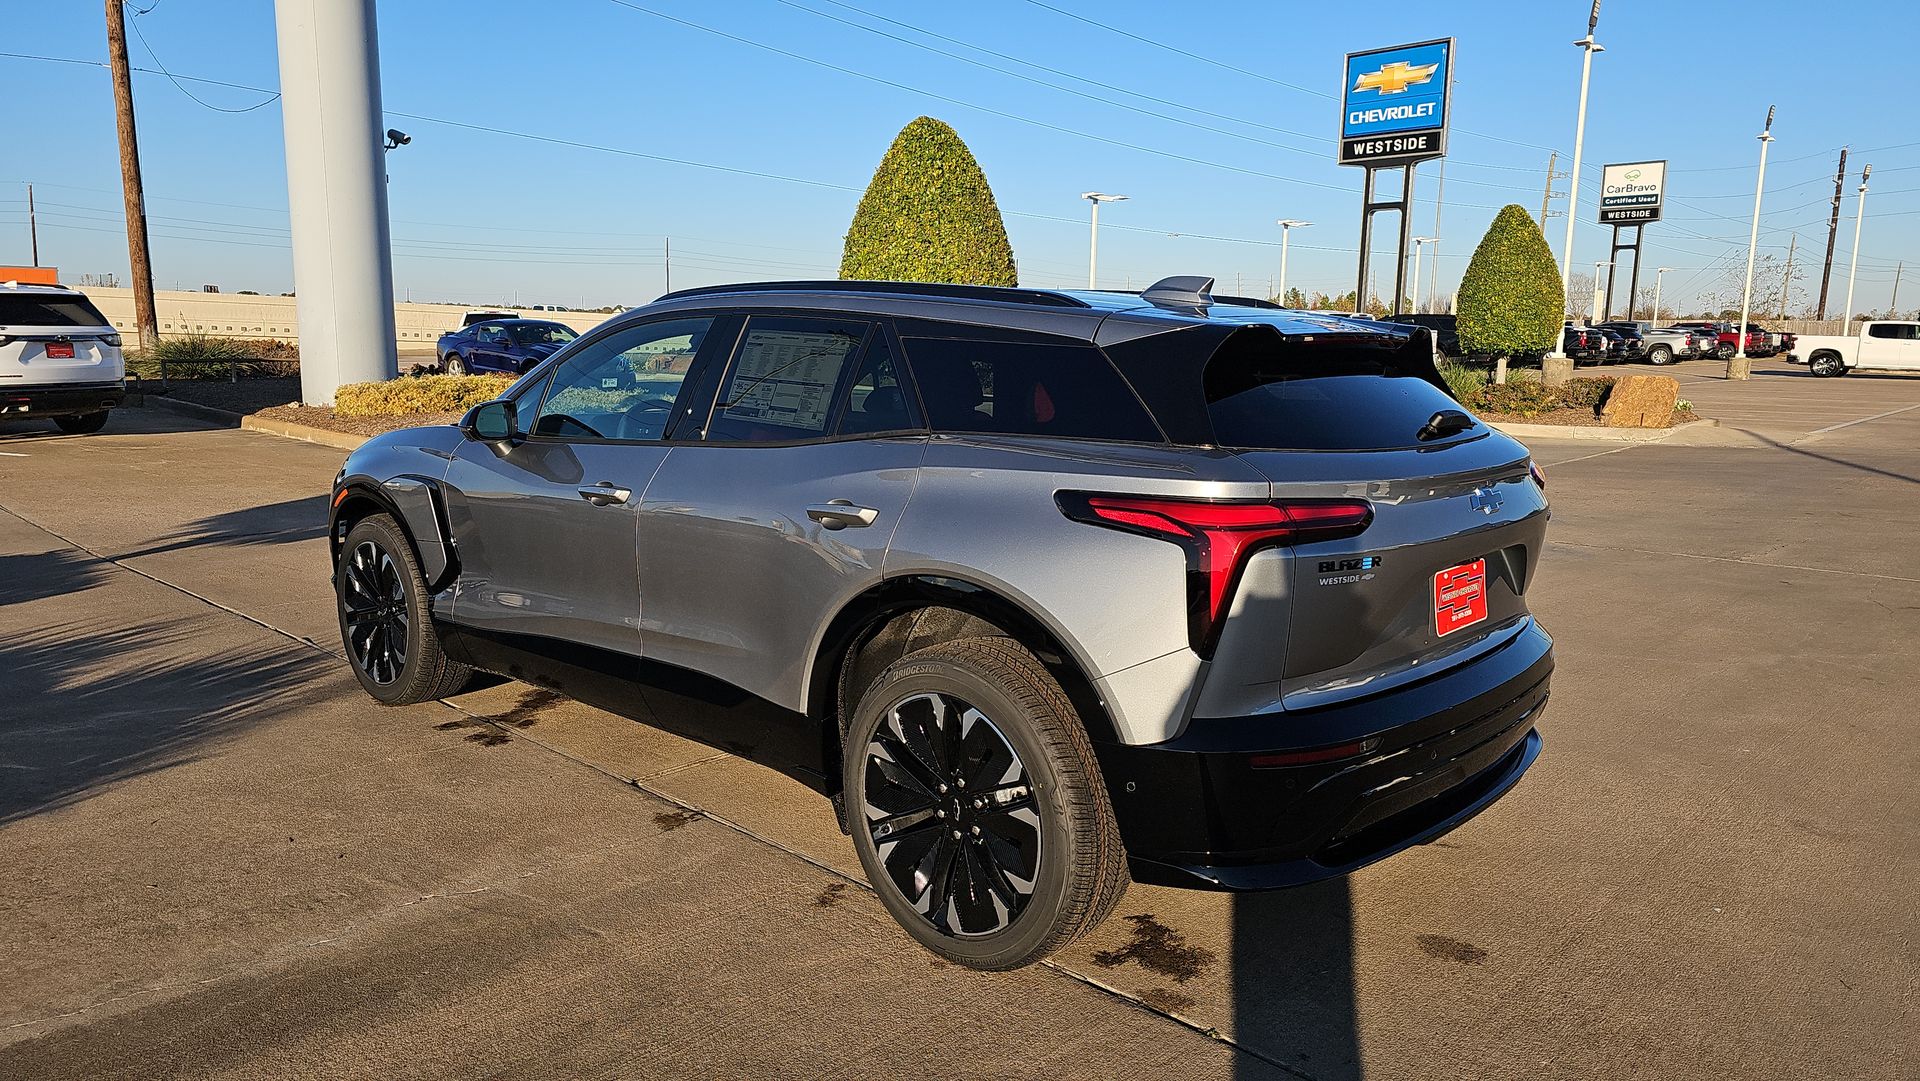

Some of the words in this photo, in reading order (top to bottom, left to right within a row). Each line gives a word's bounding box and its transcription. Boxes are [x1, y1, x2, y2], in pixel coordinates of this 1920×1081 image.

[1349, 102, 1436, 125] CHEVROLET
[1353, 136, 1427, 155] WESTSIDE
[1606, 184, 1657, 194] CarBravo
[1607, 209, 1651, 219] WESTSIDE
[1318, 556, 1382, 573] BLAZER
[1319, 574, 1361, 586] WESTSIDE
